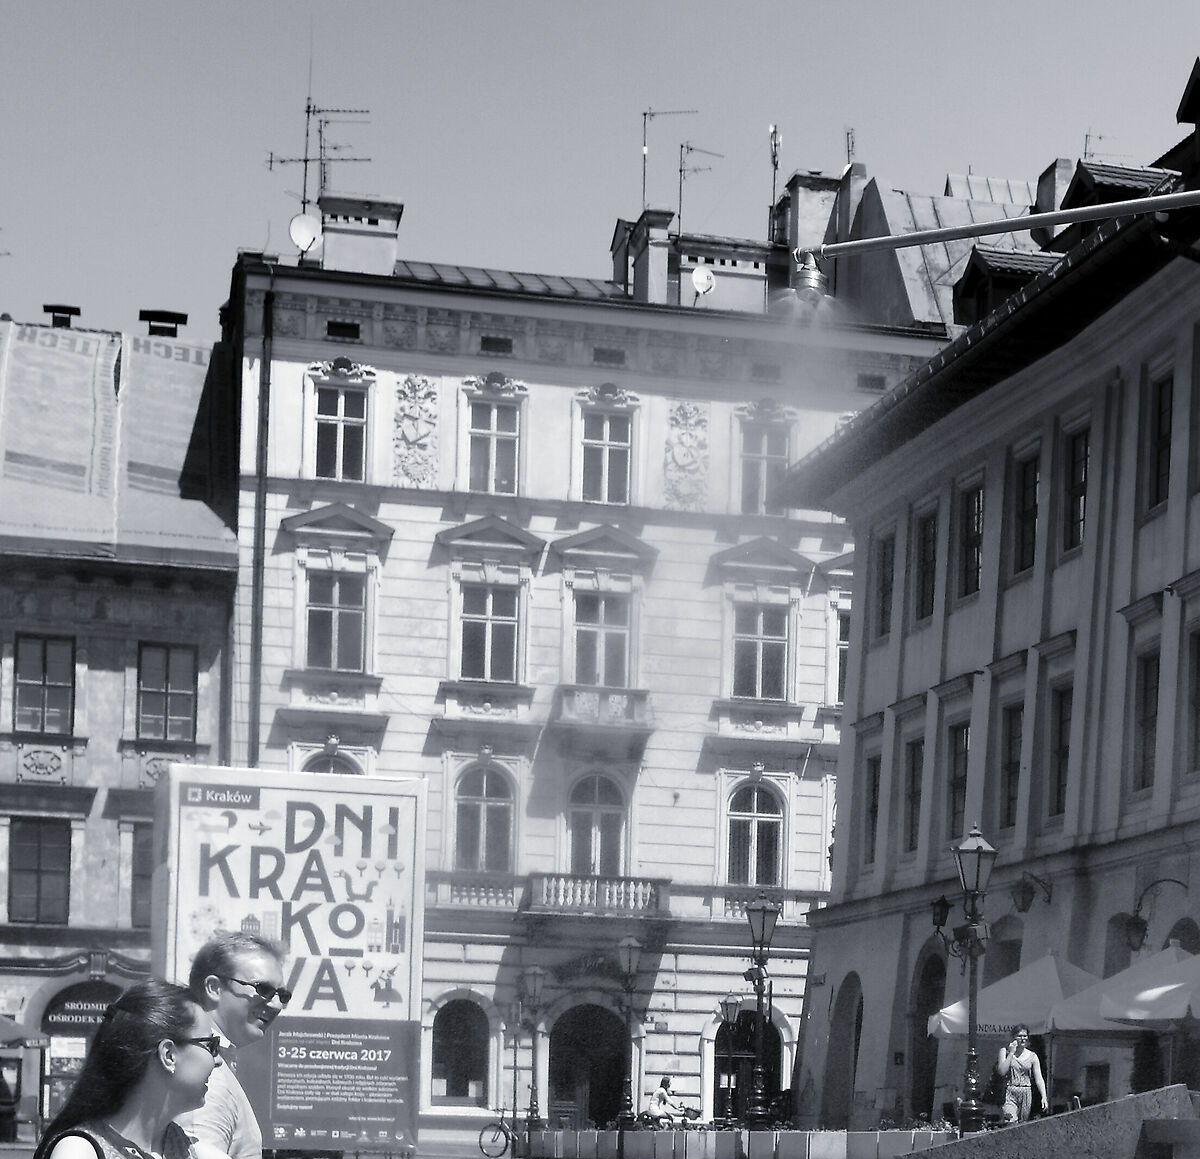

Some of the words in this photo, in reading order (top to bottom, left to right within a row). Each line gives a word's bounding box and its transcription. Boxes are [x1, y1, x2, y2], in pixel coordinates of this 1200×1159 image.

[132, 336, 208, 367] TECH
[206, 790, 252, 804] Kraków
[285, 801, 399, 859] DNI
[199, 843, 336, 903] KRA
[281, 901, 365, 957] KO
[977, 1024, 997, 1033] NDIA
[278, 1046, 307, 1059] 3-25
[309, 1049, 358, 1060] czerwca
[360, 1049, 392, 1061] 2017
